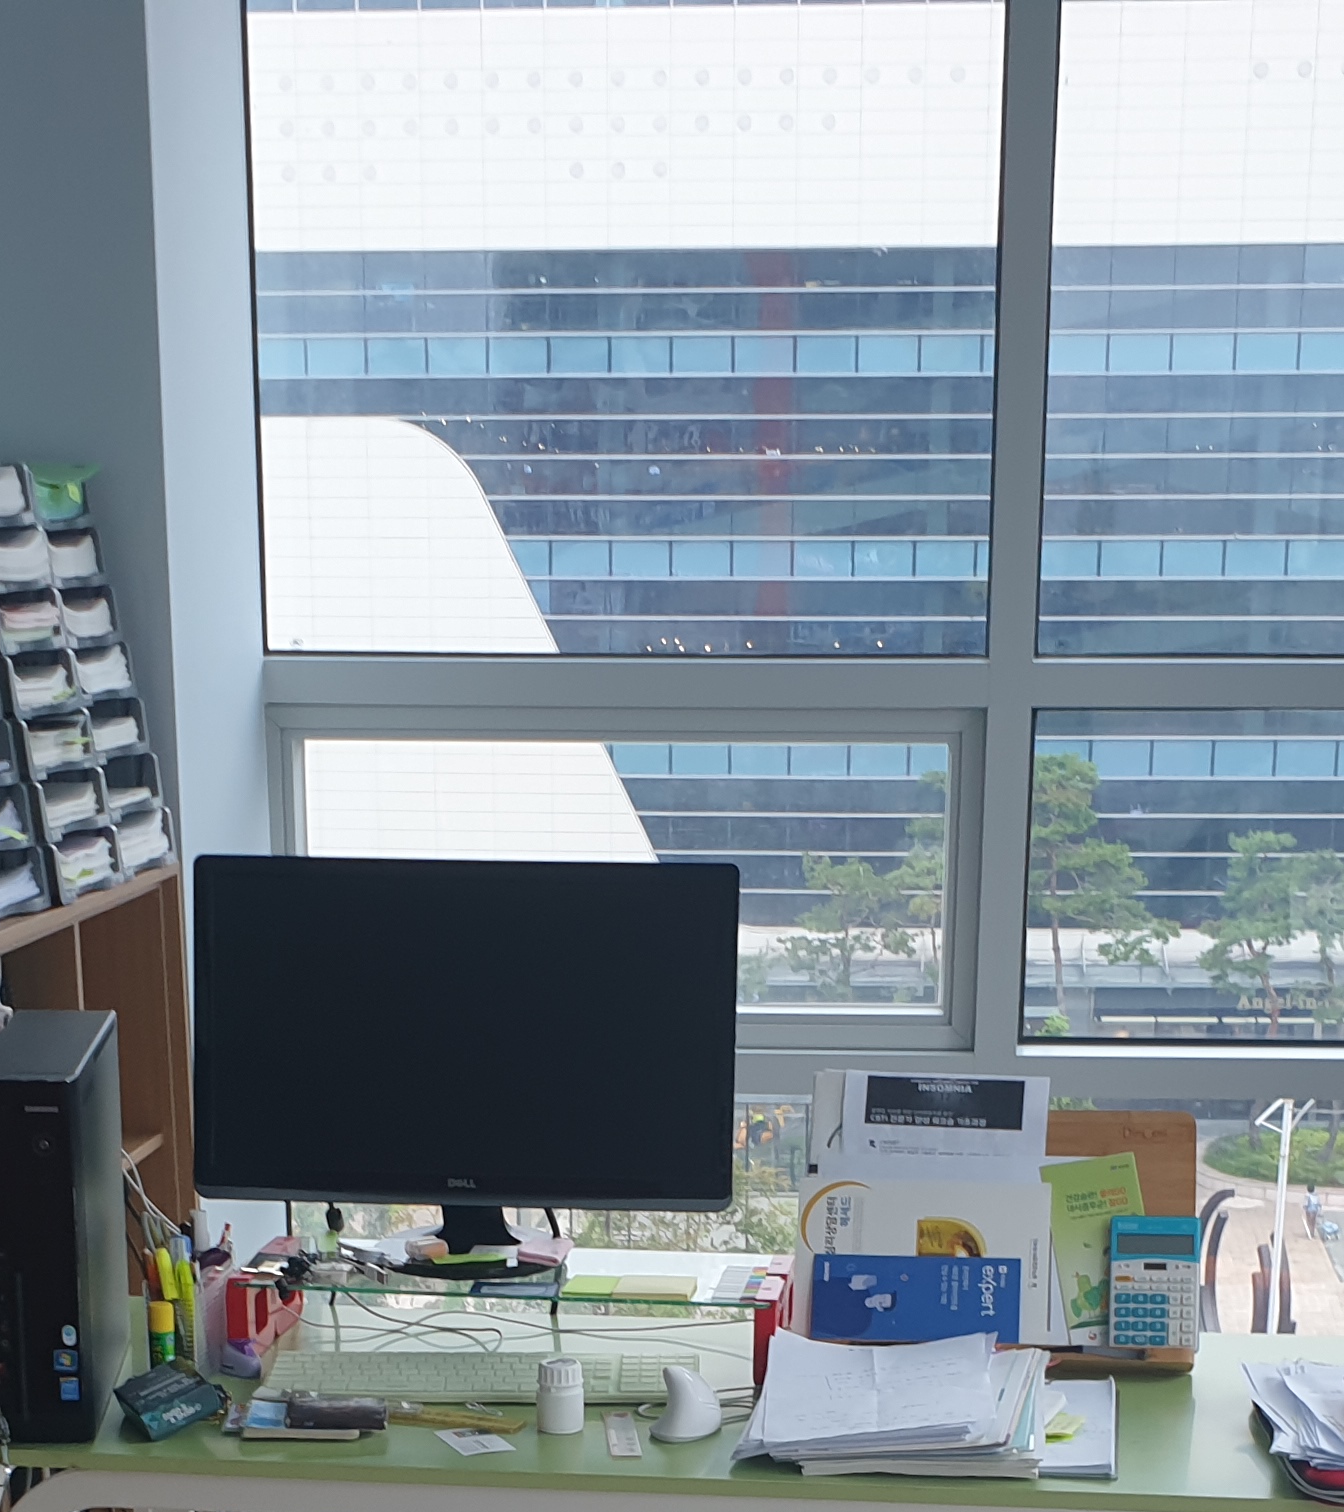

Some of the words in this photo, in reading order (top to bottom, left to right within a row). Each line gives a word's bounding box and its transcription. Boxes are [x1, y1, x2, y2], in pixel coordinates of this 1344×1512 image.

[1237, 993, 1344, 1014] Angel-in-u
[917, 1083, 974, 1094] INSOMNIA
[447, 1177, 477, 1189] DELL
[977, 1264, 997, 1317] expert
